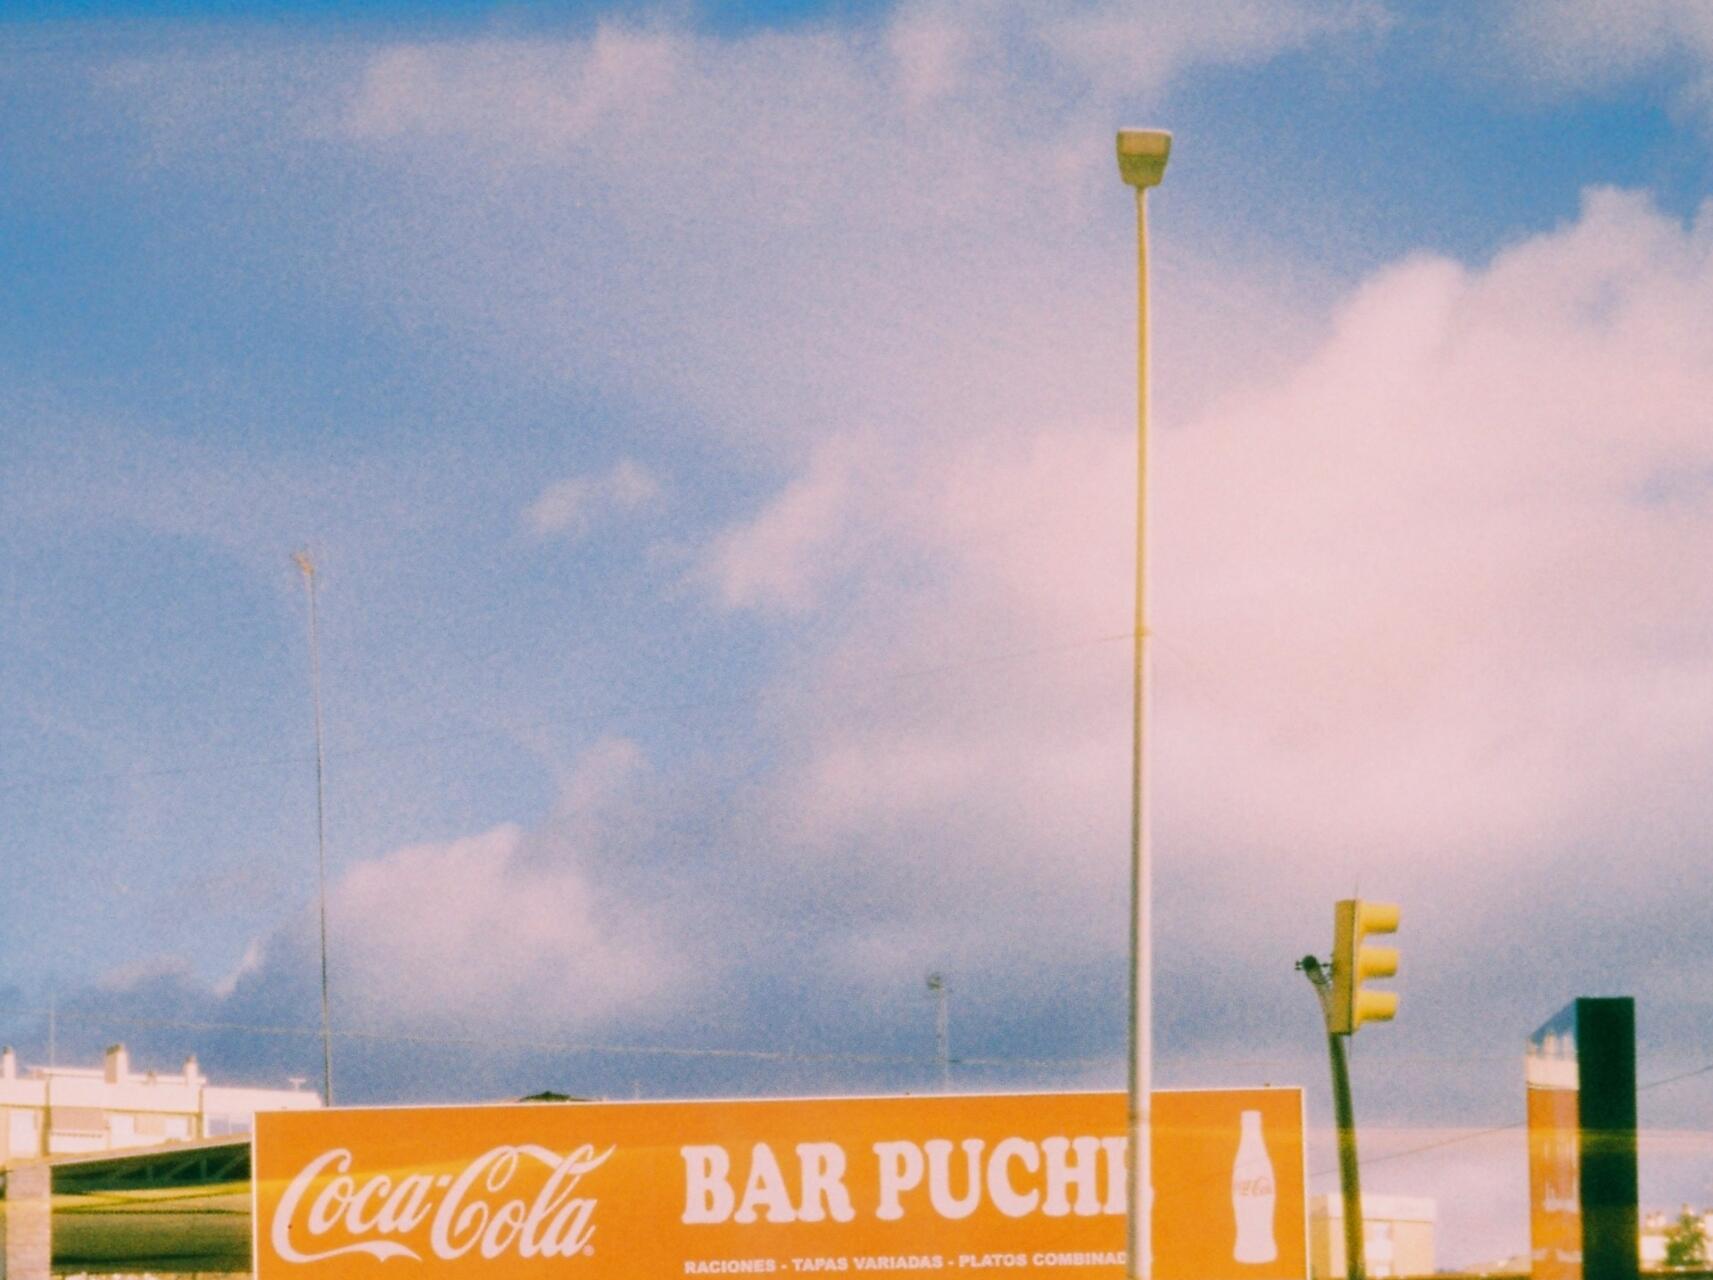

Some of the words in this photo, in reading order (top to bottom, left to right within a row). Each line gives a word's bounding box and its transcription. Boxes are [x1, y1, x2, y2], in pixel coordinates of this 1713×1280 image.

[271, 1143, 617, 1264] Coca-Cola
[680, 1142, 856, 1224] BAR
[684, 1258, 777, 1274] RACIONES
[791, 1256, 849, 1272] TAPAS
[852, 1253, 944, 1270] VARIADAS
[958, 1252, 1029, 1268] PLATOS
[1031, 1250, 1153, 1267] COMBINAD
